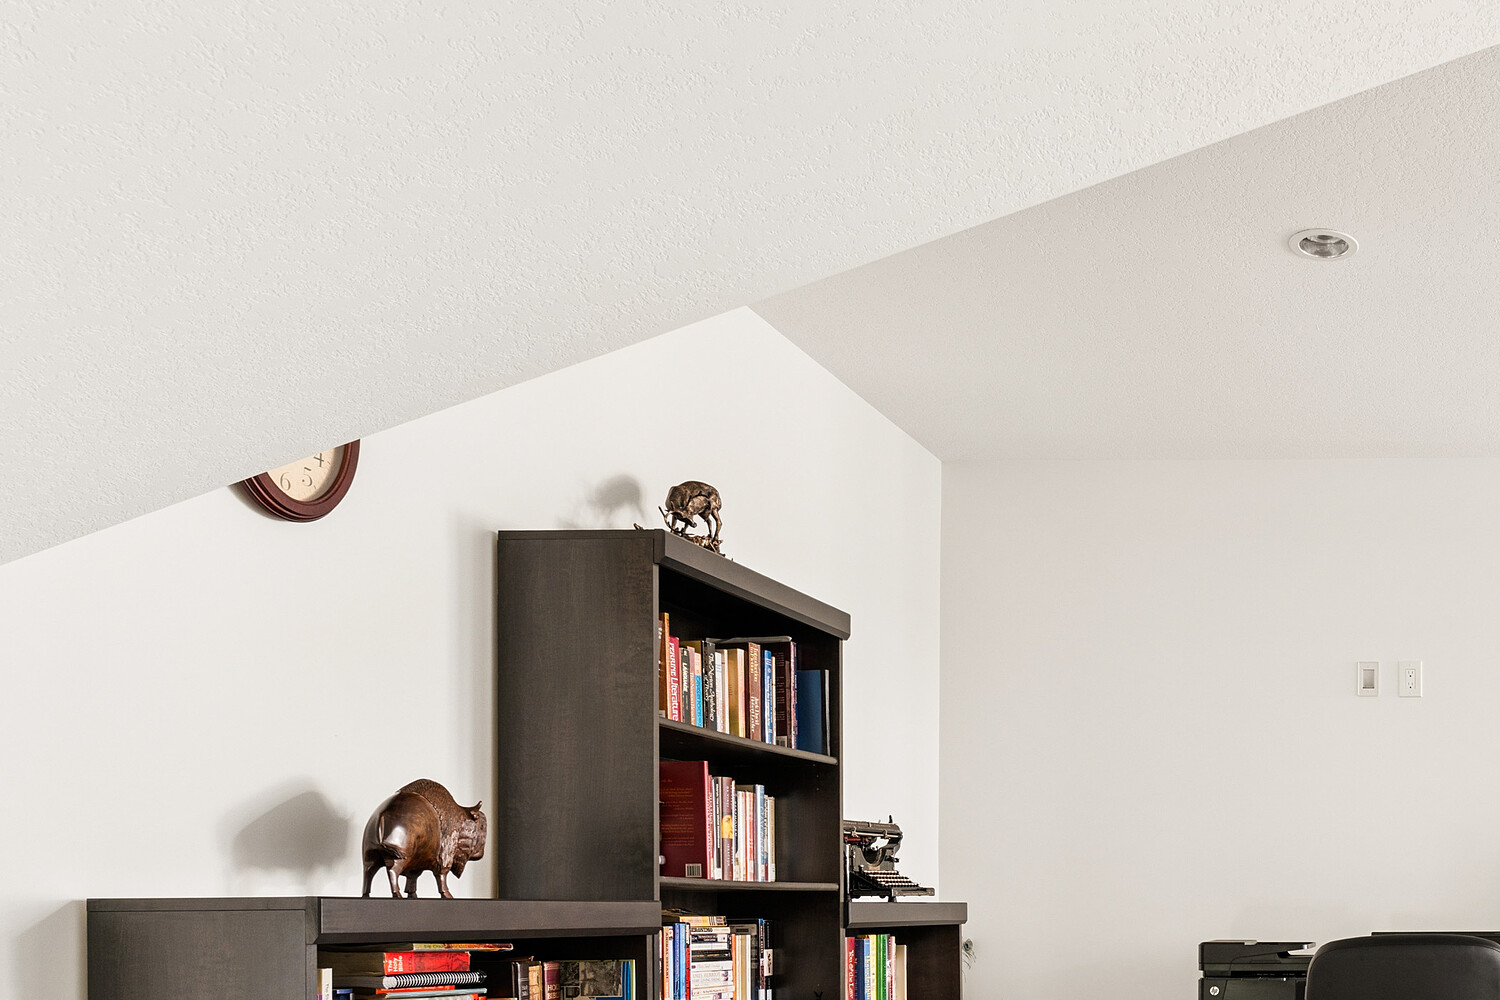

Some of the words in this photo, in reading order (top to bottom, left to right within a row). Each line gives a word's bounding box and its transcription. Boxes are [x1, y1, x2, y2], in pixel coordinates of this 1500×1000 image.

[313, 452, 324, 467] 4
[279, 471, 291, 491] 6
[301, 466, 313, 487] 5
[670, 677, 679, 721] Literature
